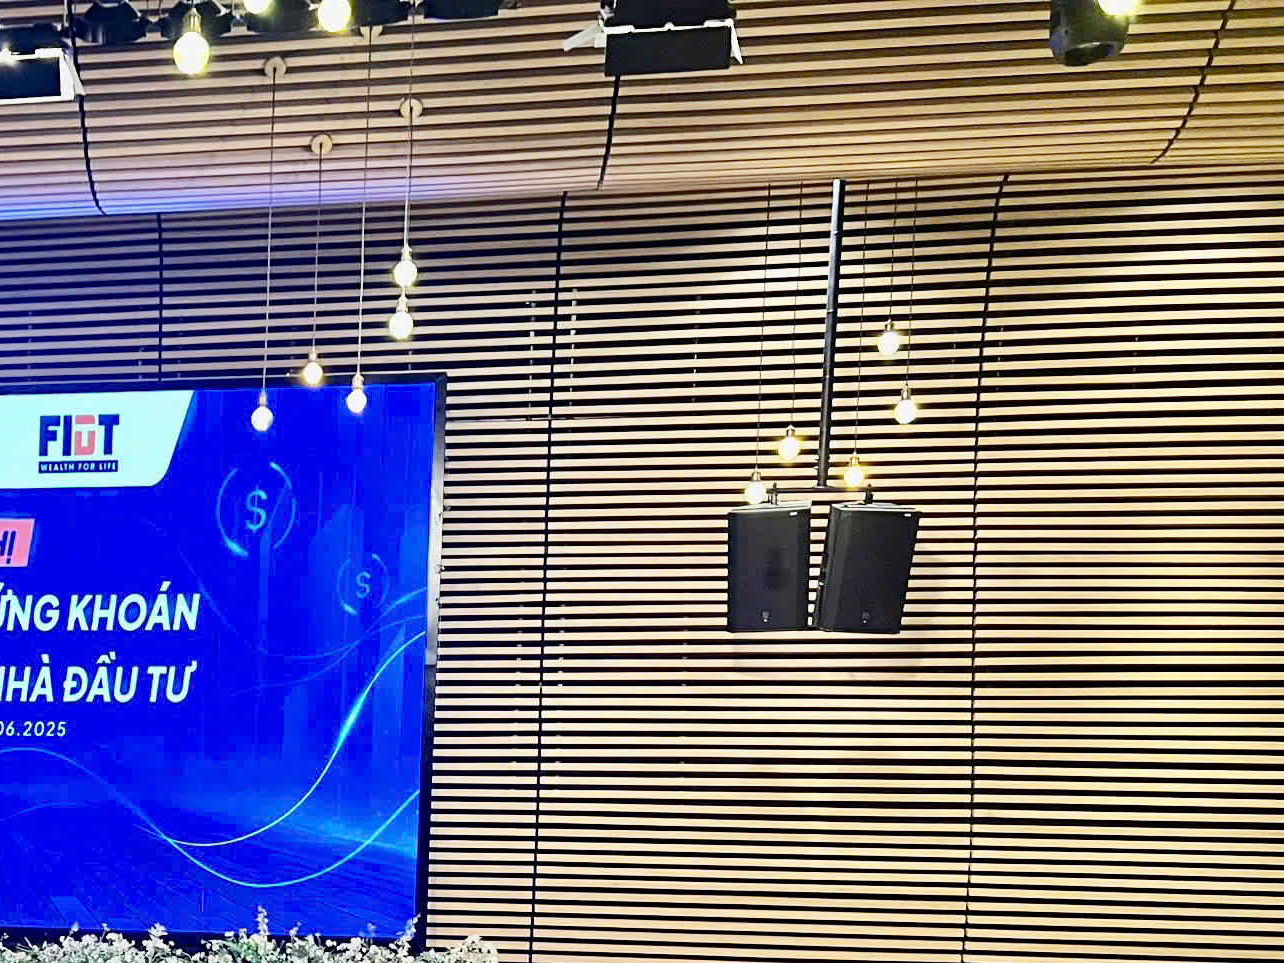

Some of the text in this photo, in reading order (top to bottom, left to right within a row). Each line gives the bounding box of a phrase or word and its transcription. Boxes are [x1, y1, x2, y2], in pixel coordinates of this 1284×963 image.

[40, 461, 117, 472] WEALTH FOR LIFE
[66, 580, 201, 632] KHOÁN
[62, 651, 139, 703] ĐẦU
[146, 660, 198, 703] TƯ
